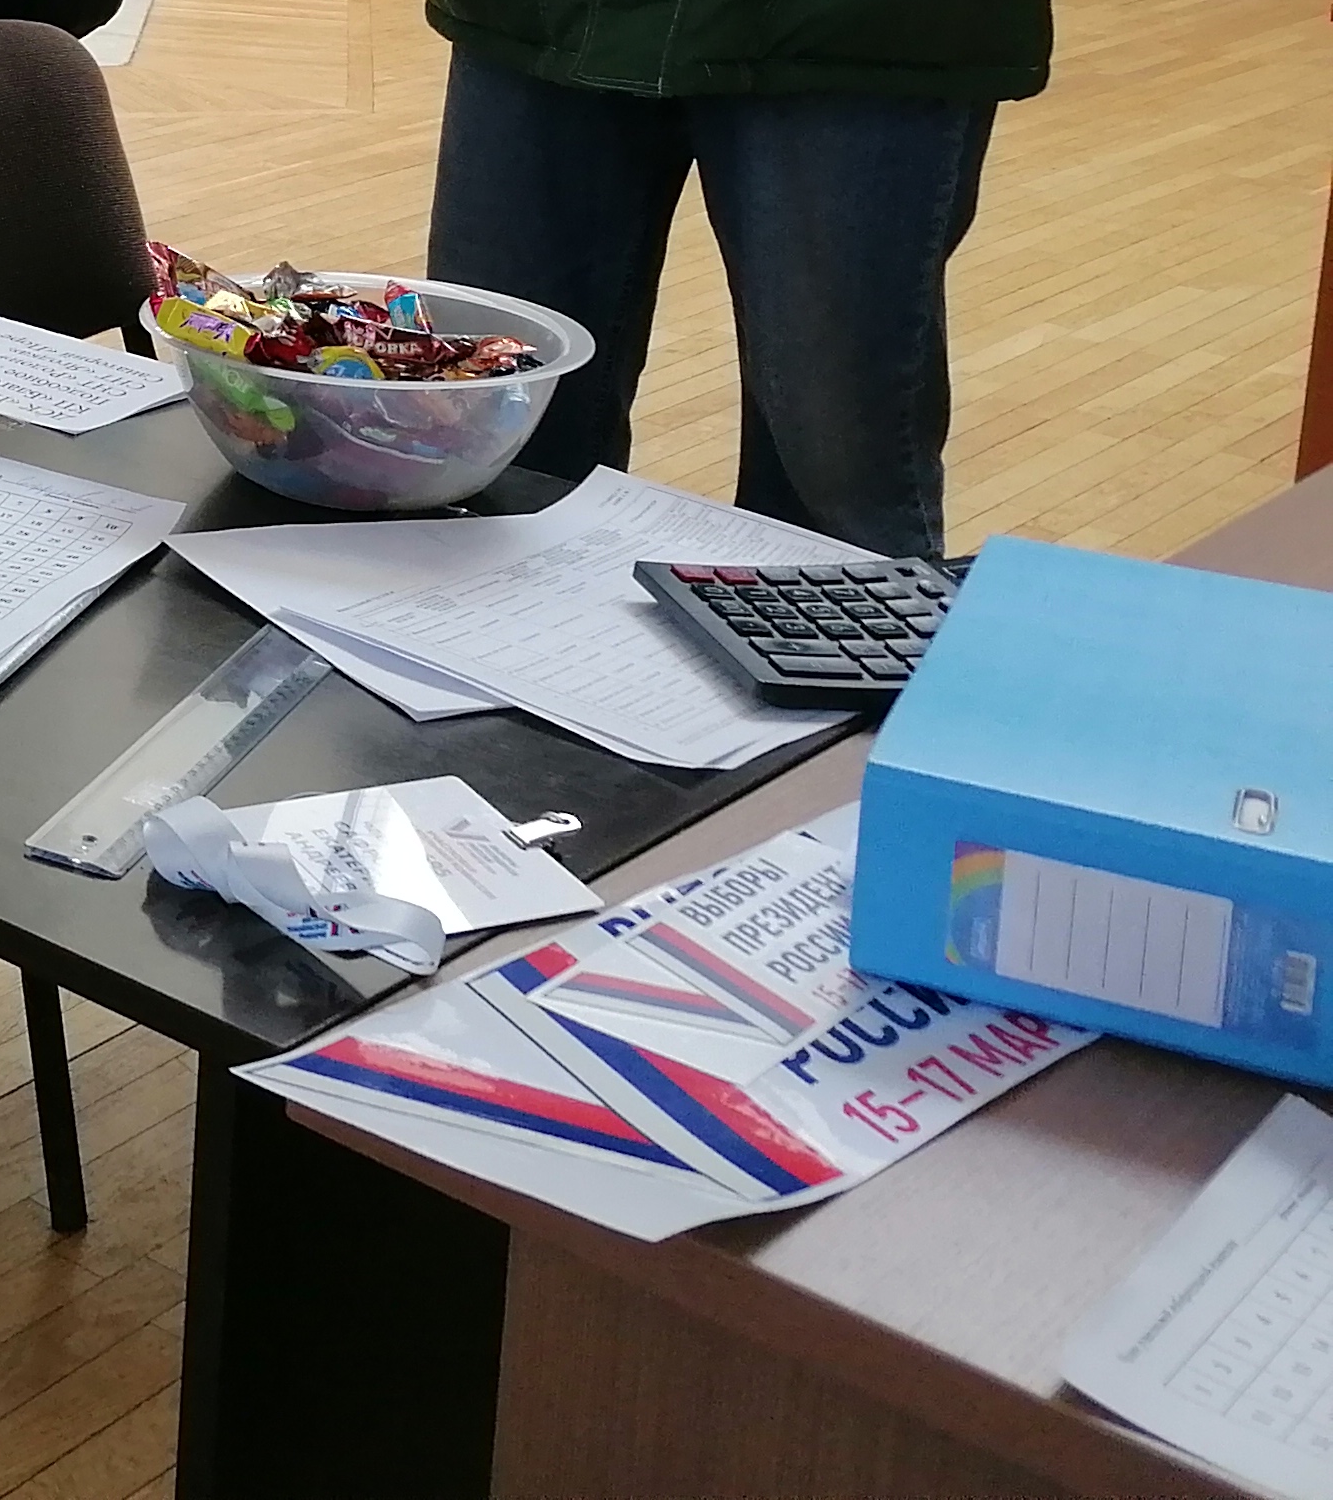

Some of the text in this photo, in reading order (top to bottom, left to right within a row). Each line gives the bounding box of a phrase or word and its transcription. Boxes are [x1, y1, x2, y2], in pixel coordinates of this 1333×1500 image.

[62, 351, 164, 383] Санаторий
[96, 374, 145, 390] СНТ
[4, 368, 110, 406] Подсобное
[77, 380, 127, 398] СНТ
[18, 403, 77, 420] ДСК
[54, 400, 91, 414] КП
[285, 831, 357, 892] АНДРЕЕВ
[678, 857, 790, 927] ВЫБОРЫ
[722, 863, 848, 956] ПРЕЗИДЕНТ
[948, 1010, 1060, 1079] МАР
